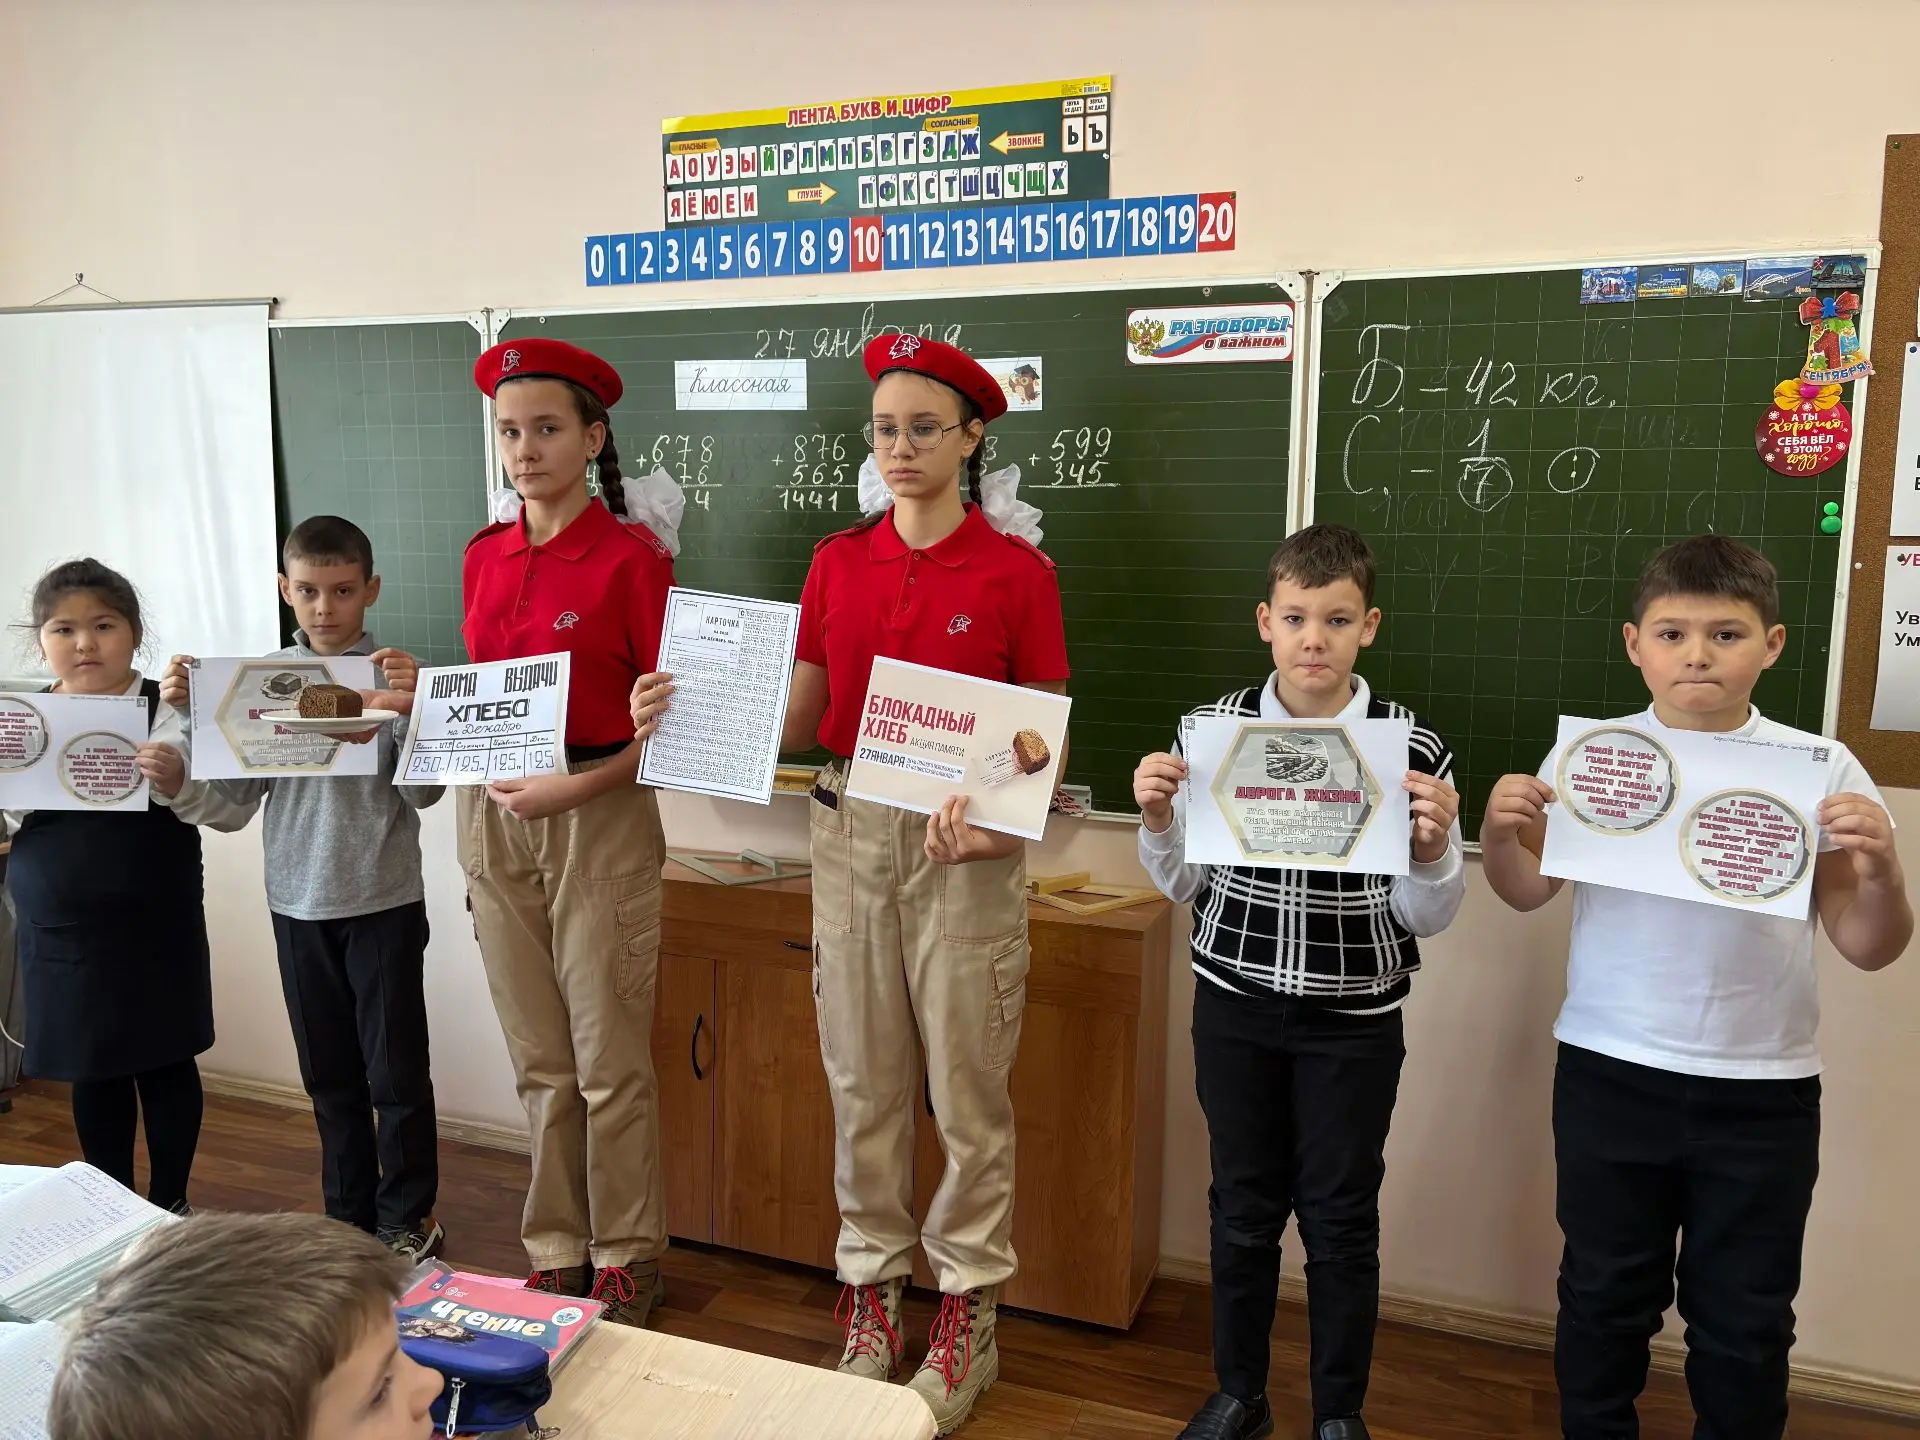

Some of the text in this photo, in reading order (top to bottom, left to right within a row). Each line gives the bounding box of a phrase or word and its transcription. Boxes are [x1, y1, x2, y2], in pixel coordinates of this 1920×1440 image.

[787, 95, 952, 126] ЛЕНТА БУКВ И ЦИФР
[930, 117, 972, 129] СОГЛАСНЫЕ
[1068, 123, 1104, 146] Ь Ъ
[678, 142, 708, 151] ГЛАСНЫЕ
[1008, 136, 1043, 147] ЗВОНКИЕ
[670, 132, 980, 179] А О У Э Ы Й Р Л М Н Б В Г З Д Ж
[797, 189, 823, 200] ГЛУХИЕ
[861, 168, 1065, 205] П Ф К С Т Ш Ц Ч Щ Х
[670, 190, 755, 217] Я Ё Ю Е И
[590, 201, 1234, 278] 0 1 2 3 4 5 6 7 8 9 10 11 12 13 14 15 16 17 18 19 20
[1170, 316, 1290, 337] РАЗГОВОРЫ
[1218, 334, 1287, 350] важном
[688, 367, 792, 393] Классная
[1466, 356, 1517, 407] 42
[1792, 413, 1818, 422] А ТЫ
[652, 434, 715, 463] 678
[794, 434, 846, 463] 876
[1049, 426, 1112, 462] 599
[1777, 434, 1834, 446] СЕБЯ ВЁЛ
[1784, 445, 1823, 454] В ЭТОМ
[790, 463, 850, 486] 565
[1050, 460, 1110, 486] 345
[779, 489, 841, 512] 1441
[706, 616, 740, 628] КАРТОЧКА
[430, 661, 558, 699] НОРМА ВЫДАЧИ
[867, 694, 976, 736] БЛОКАДНЫЙ
[462, 720, 522, 735] Декабрь
[862, 716, 909, 745] ХЛЕБ
[1234, 786, 1364, 804] ДОРОГА ЖИЗНИ
